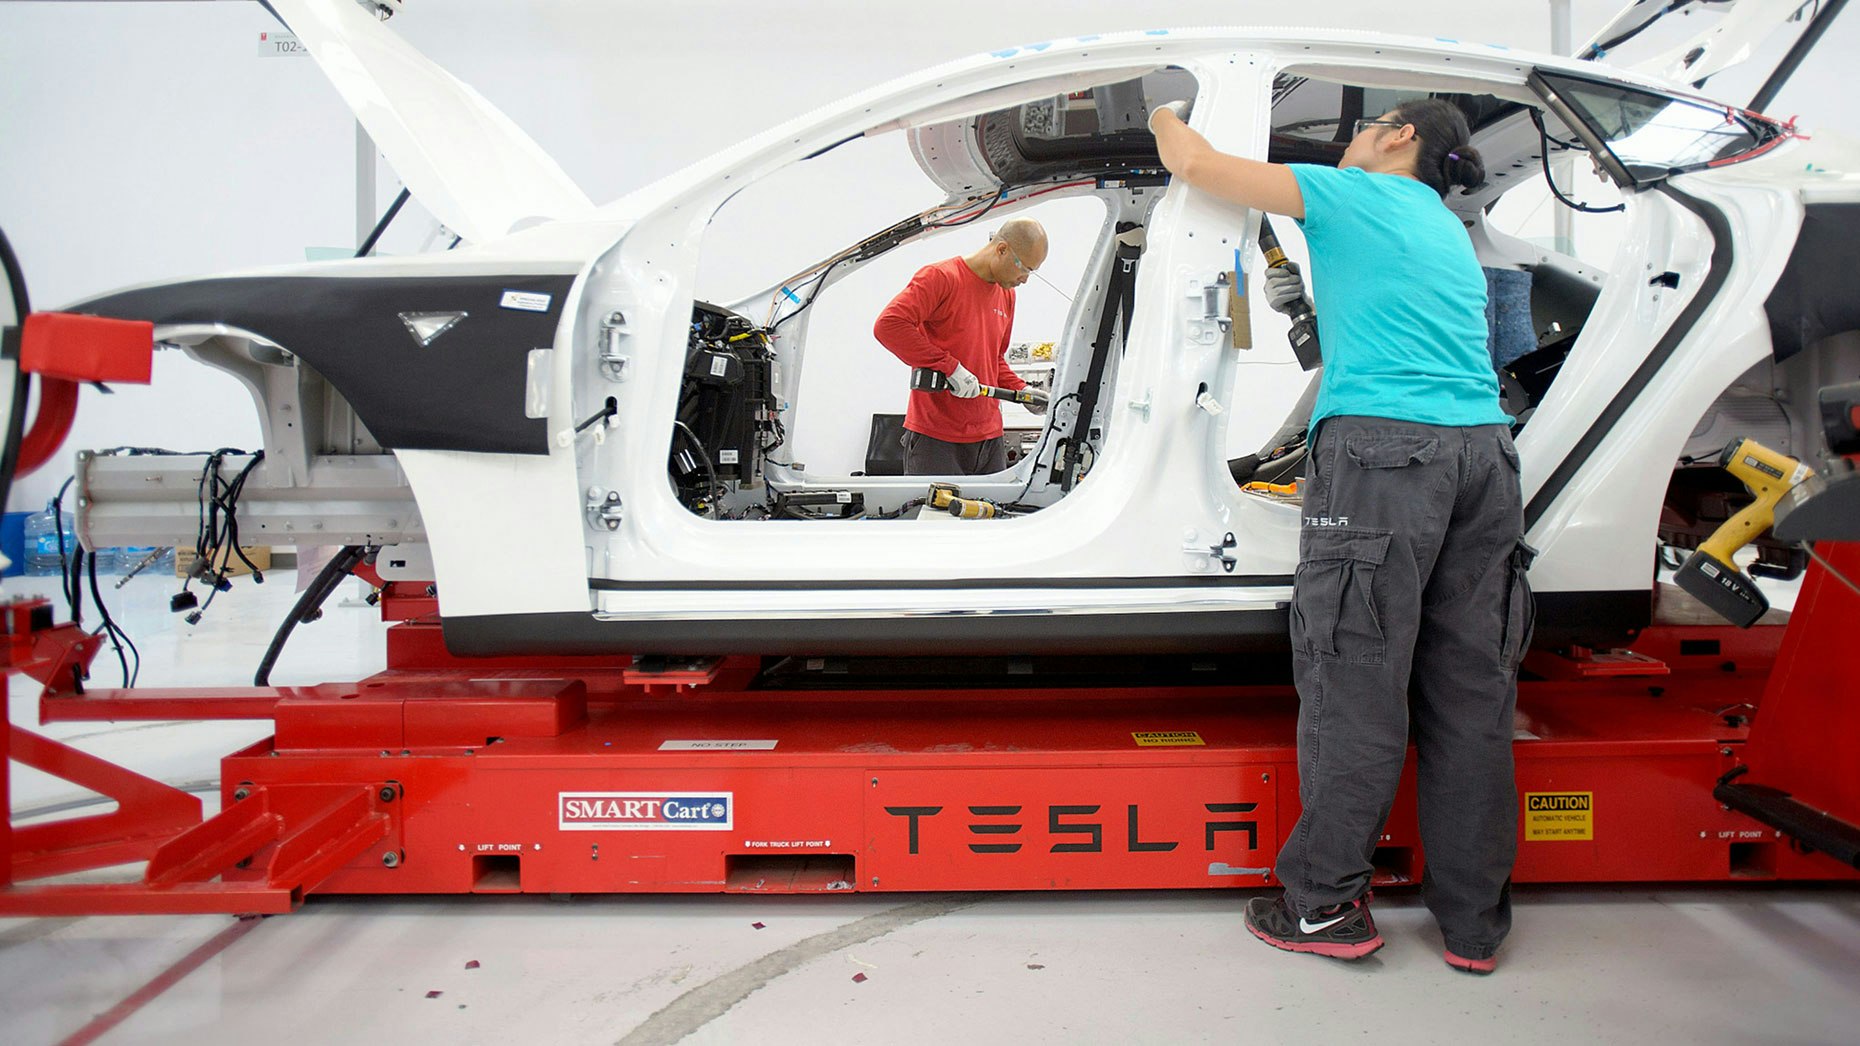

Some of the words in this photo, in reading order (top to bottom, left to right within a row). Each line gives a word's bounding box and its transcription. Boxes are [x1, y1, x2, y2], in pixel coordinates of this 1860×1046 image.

[1305, 516, 1348, 526] TESLA
[1721, 577, 1732, 588] 18
[1732, 583, 1740, 591] V
[565, 800, 660, 819] SMART
[1530, 797, 1588, 809] CAUTION
[884, 803, 1258, 854] TESLA
